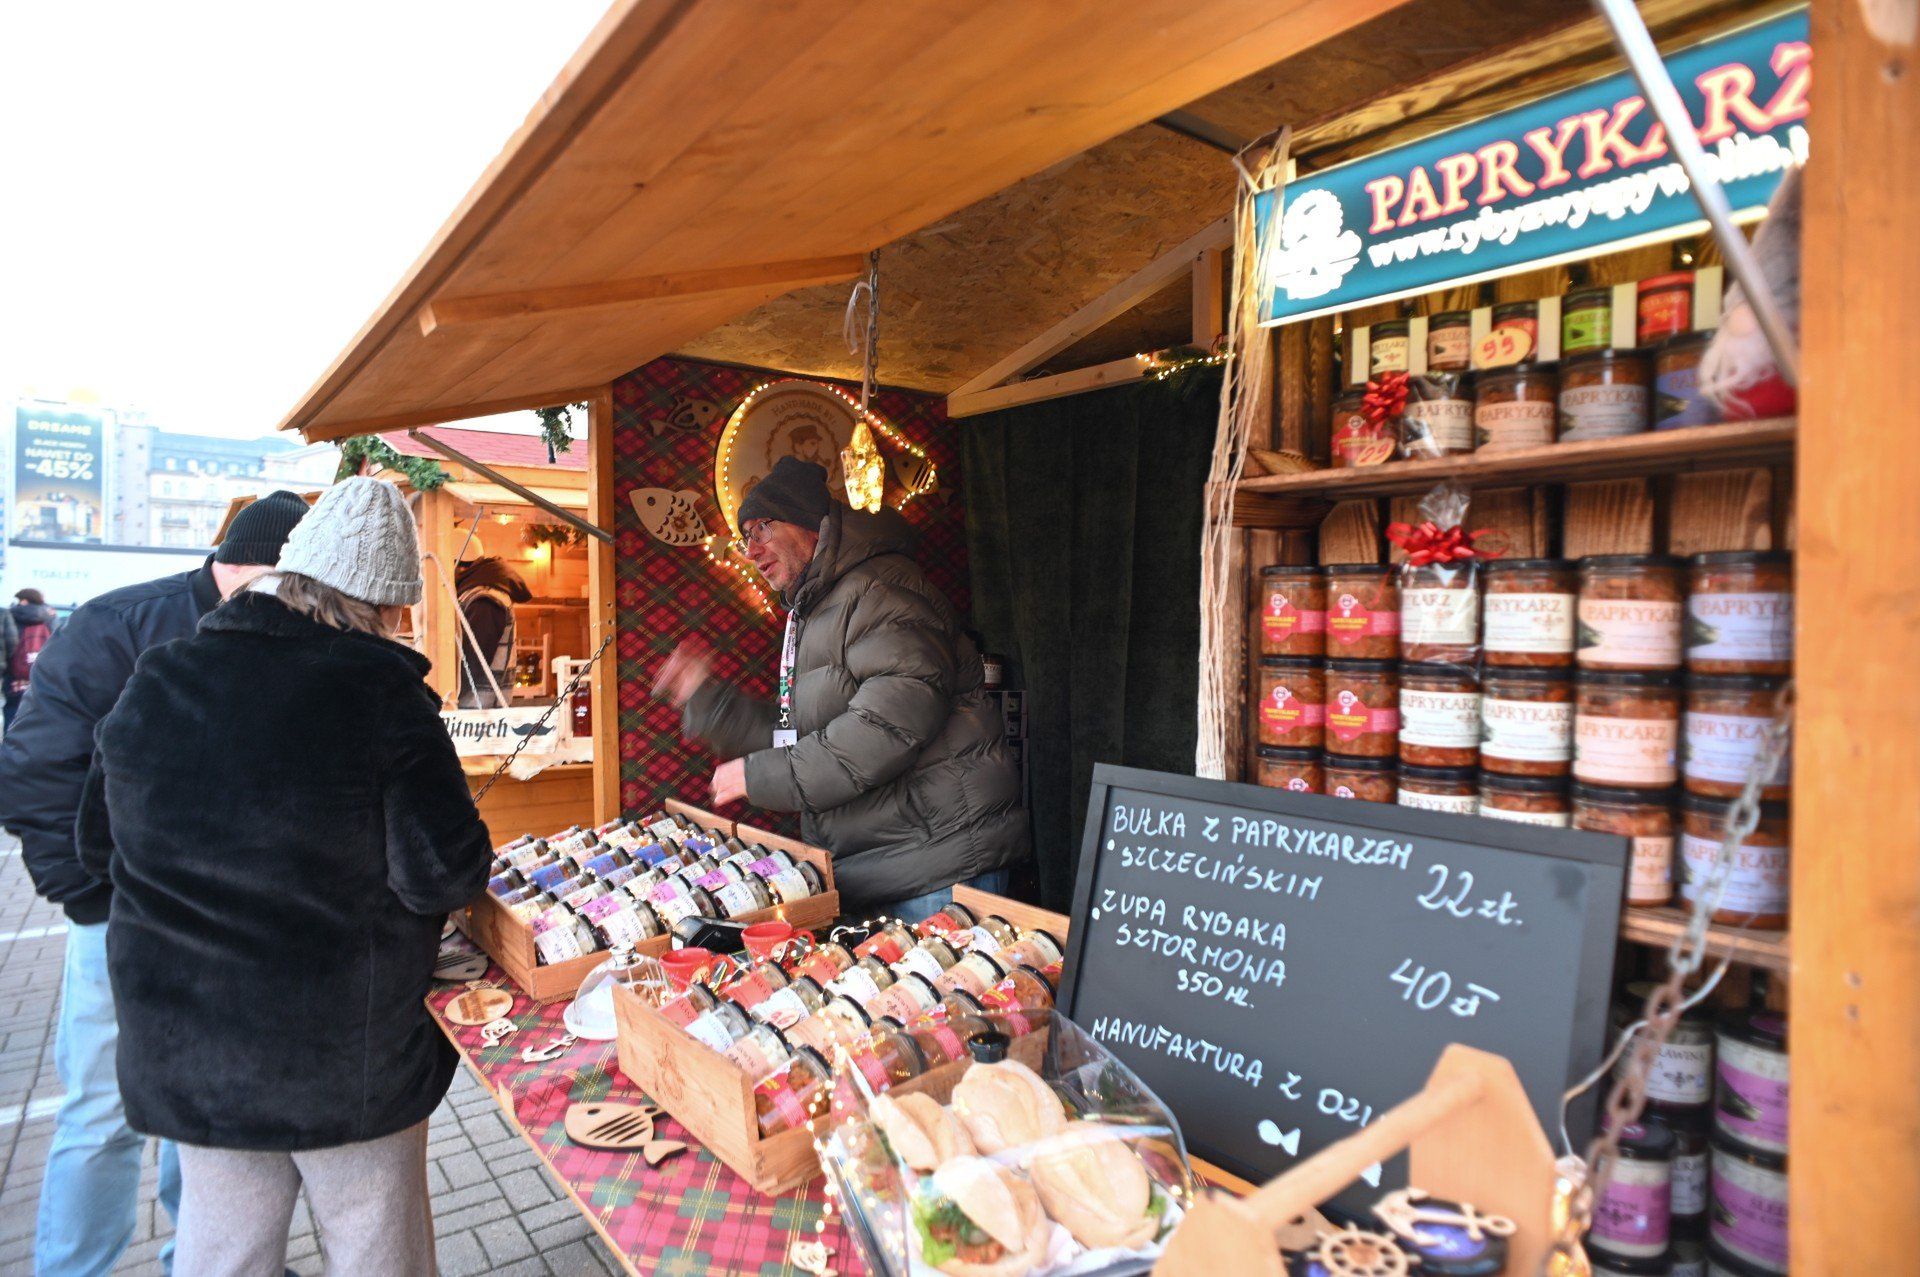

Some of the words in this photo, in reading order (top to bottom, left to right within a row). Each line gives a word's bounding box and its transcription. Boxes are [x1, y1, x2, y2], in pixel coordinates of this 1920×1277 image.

[1365, 41, 1814, 235] PAPRYKRZ
[25, 459, 94, 480] -45%
[1113, 805, 1187, 838] BUŁKA
[1202, 815, 1220, 843] Z
[1231, 816, 1414, 871] PAPRYKARZEM
[1121, 846, 1324, 901] SZCZECIŃSKIM
[1416, 864, 1475, 918] 22
[1102, 888, 1167, 927] ZUPA
[1182, 904, 1287, 952] RYBAKA
[1115, 922, 1287, 988] SZTORMOWA
[1176, 968, 1224, 997] 350
[1389, 957, 1453, 1010] 40
[1091, 1016, 1264, 1088] MANUFAKTURA
[1278, 1070, 1302, 1100] Z
